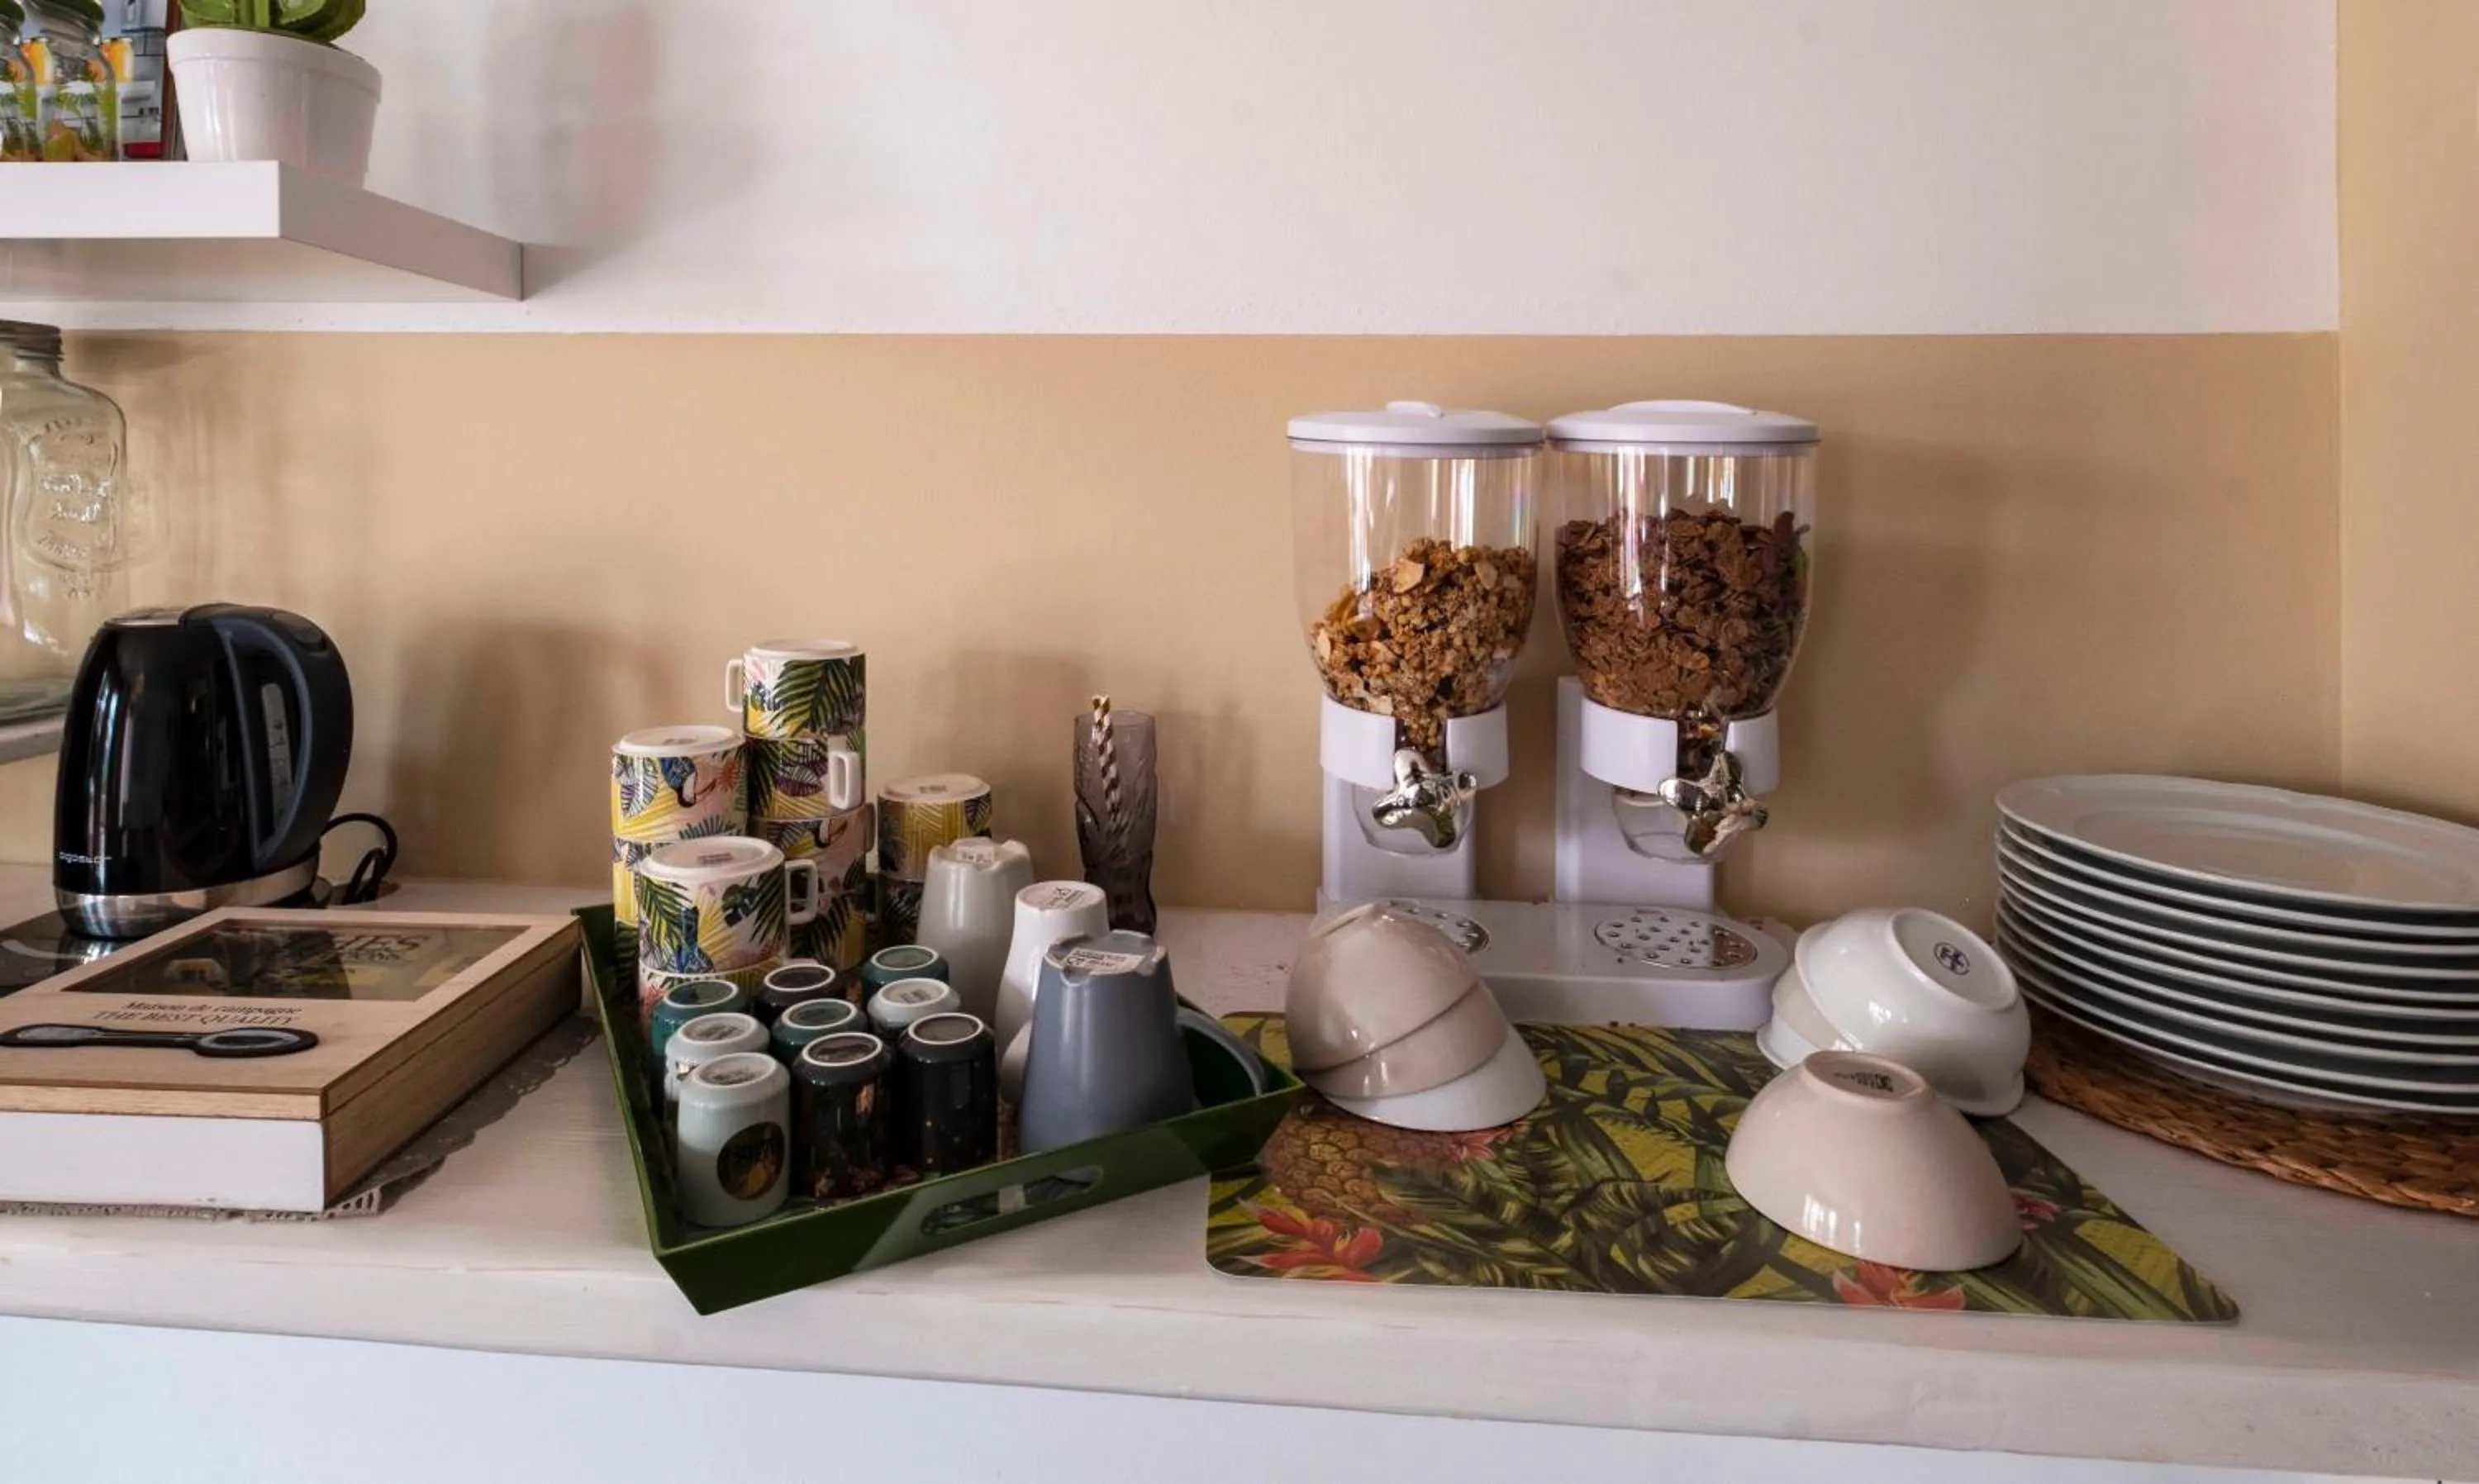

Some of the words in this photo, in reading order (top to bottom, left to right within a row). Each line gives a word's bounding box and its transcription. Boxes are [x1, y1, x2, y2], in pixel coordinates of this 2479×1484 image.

[121, 1001, 187, 1011] Maison
[188, 1003, 212, 1011] de
[213, 1004, 302, 1015] campagne
[93, 1011, 139, 1021] THE
[140, 1012, 202, 1023] BEST
[201, 1014, 298, 1025] QUALITY
